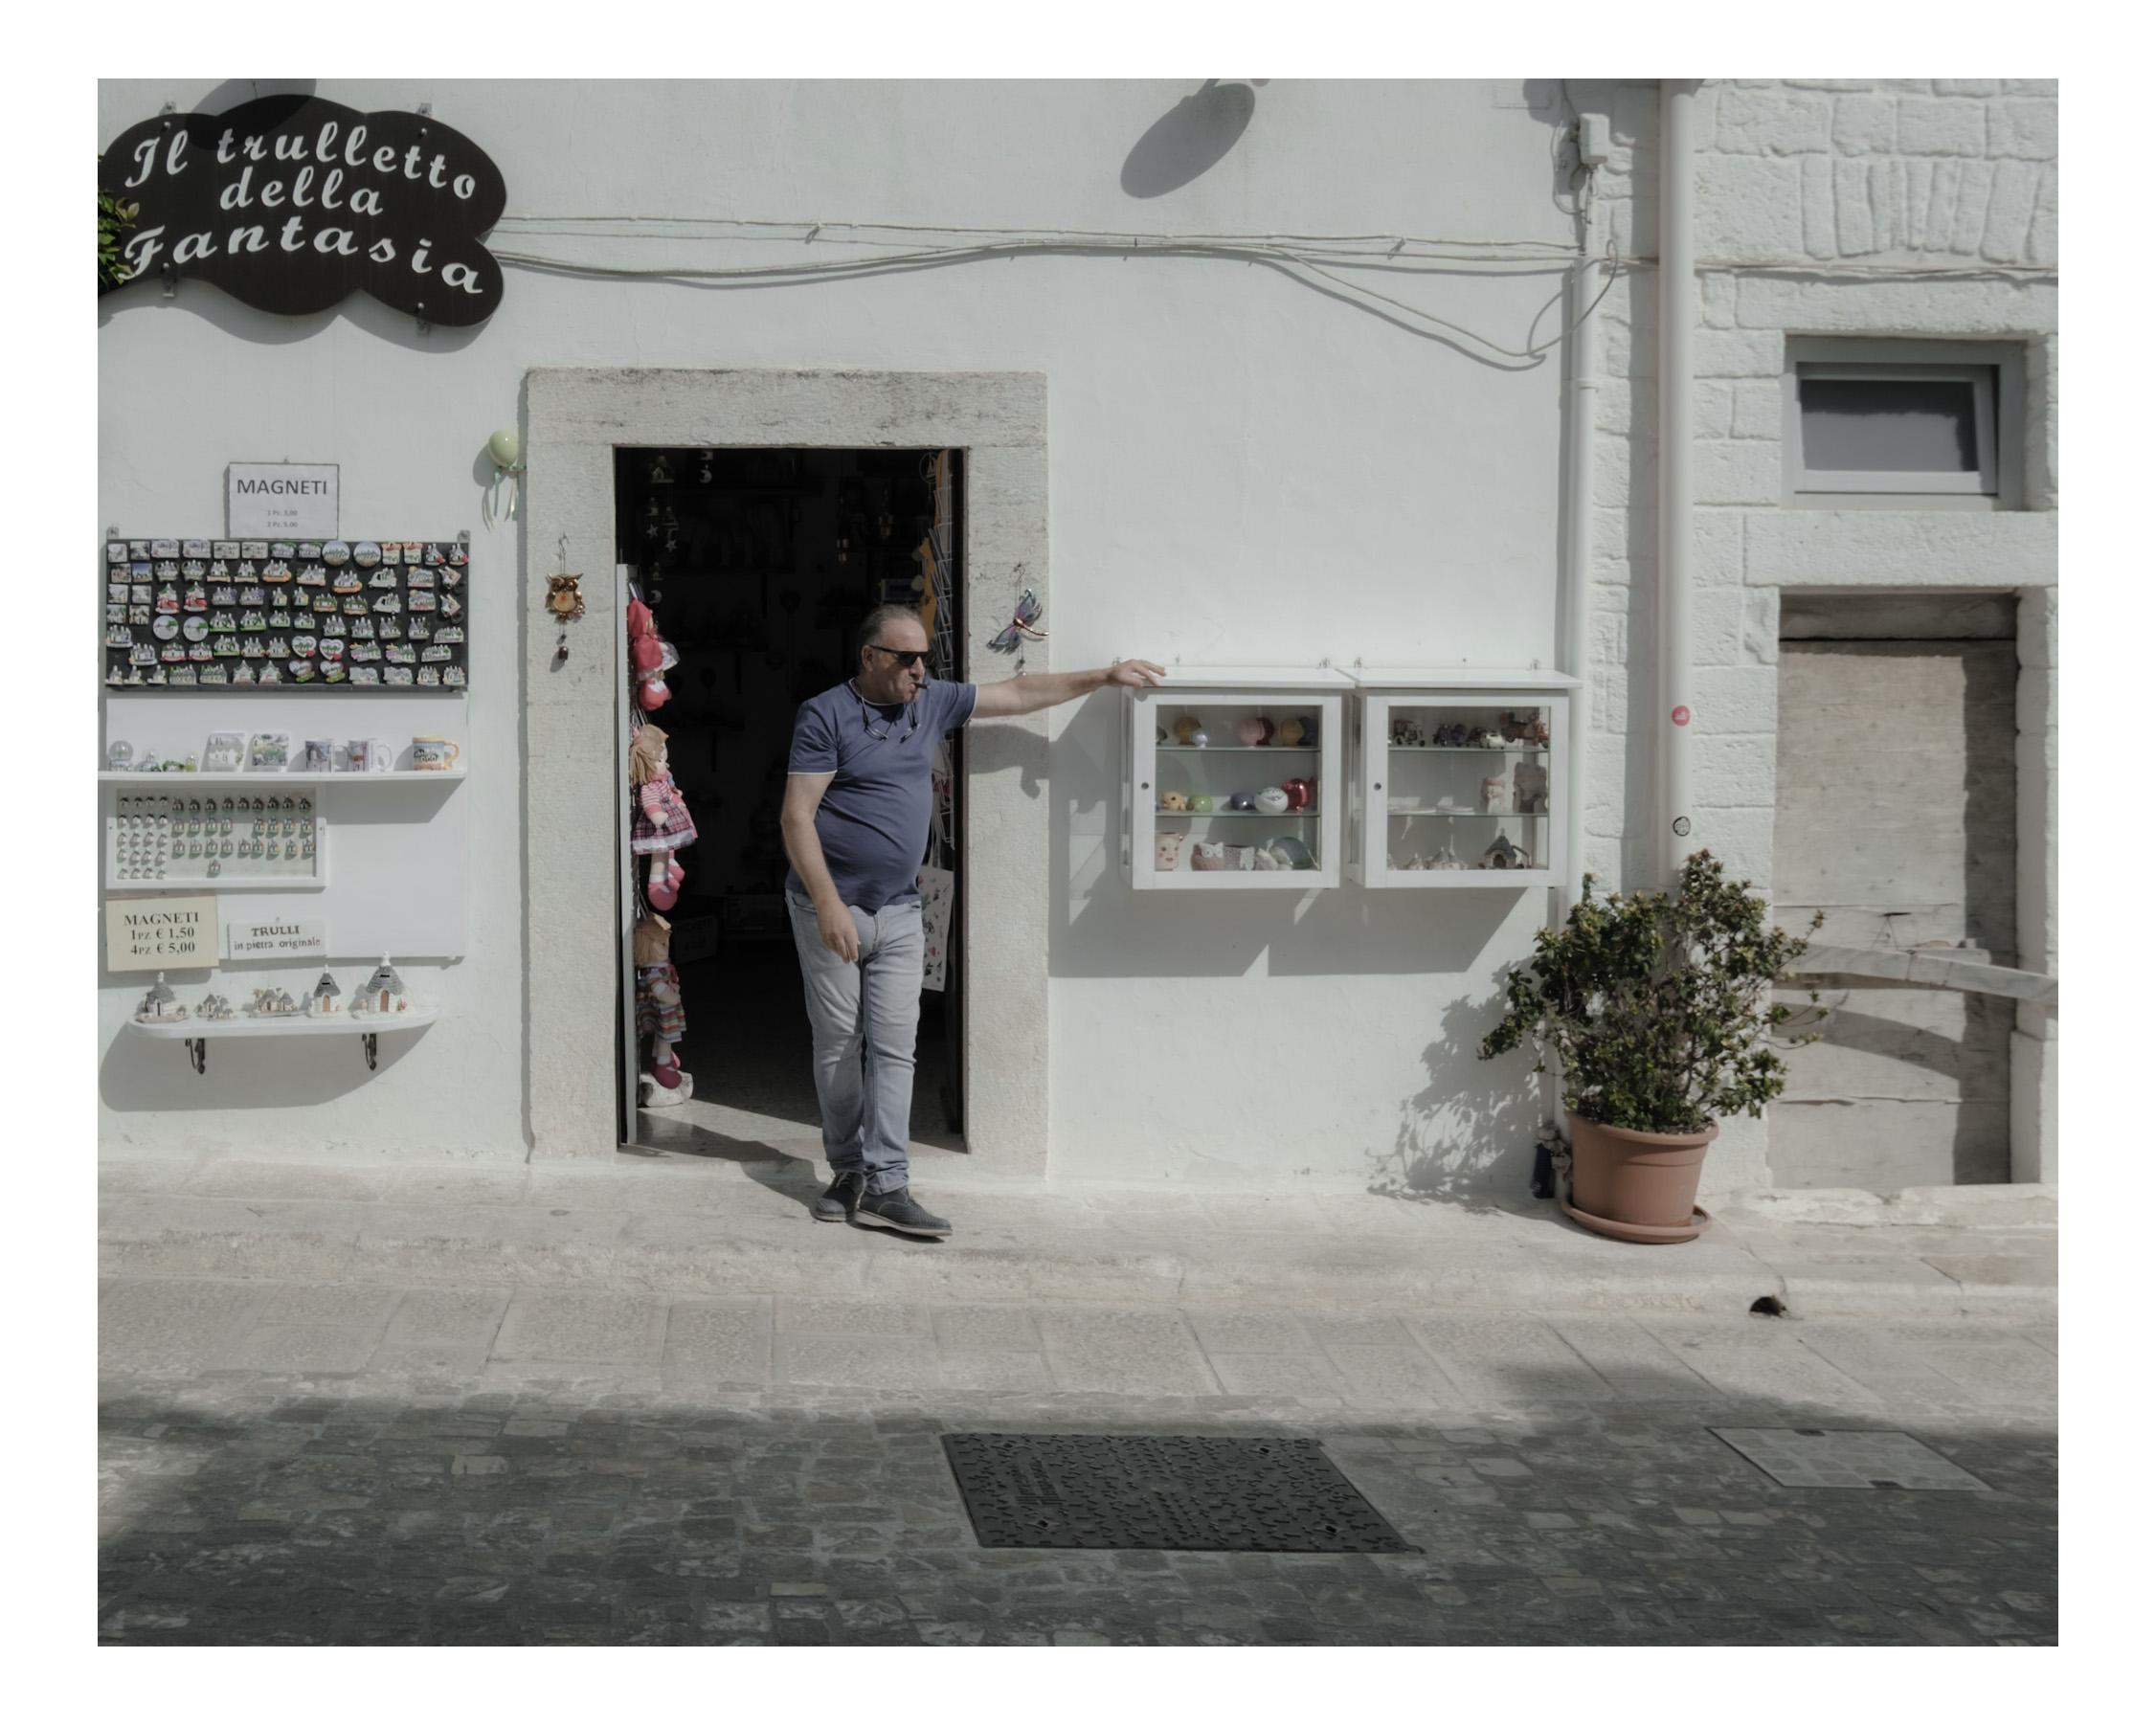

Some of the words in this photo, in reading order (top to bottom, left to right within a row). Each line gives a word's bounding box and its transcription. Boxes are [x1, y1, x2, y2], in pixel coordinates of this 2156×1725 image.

[124, 129, 189, 189] Il
[216, 121, 476, 199] trulletto
[220, 166, 383, 216] della
[118, 214, 483, 294] Fantasia
[236, 479, 327, 495] MAGNETI
[124, 912, 199, 926] MAGNETI
[156, 928, 164, 939] €
[168, 927, 195, 939] 1,50
[251, 925, 300, 937] TRULLI
[156, 943, 164, 954] €
[168, 942, 195, 954] 5,00
[235, 941, 243, 951] in
[246, 940, 274, 952] pietra
[279, 936, 321, 950] originale
